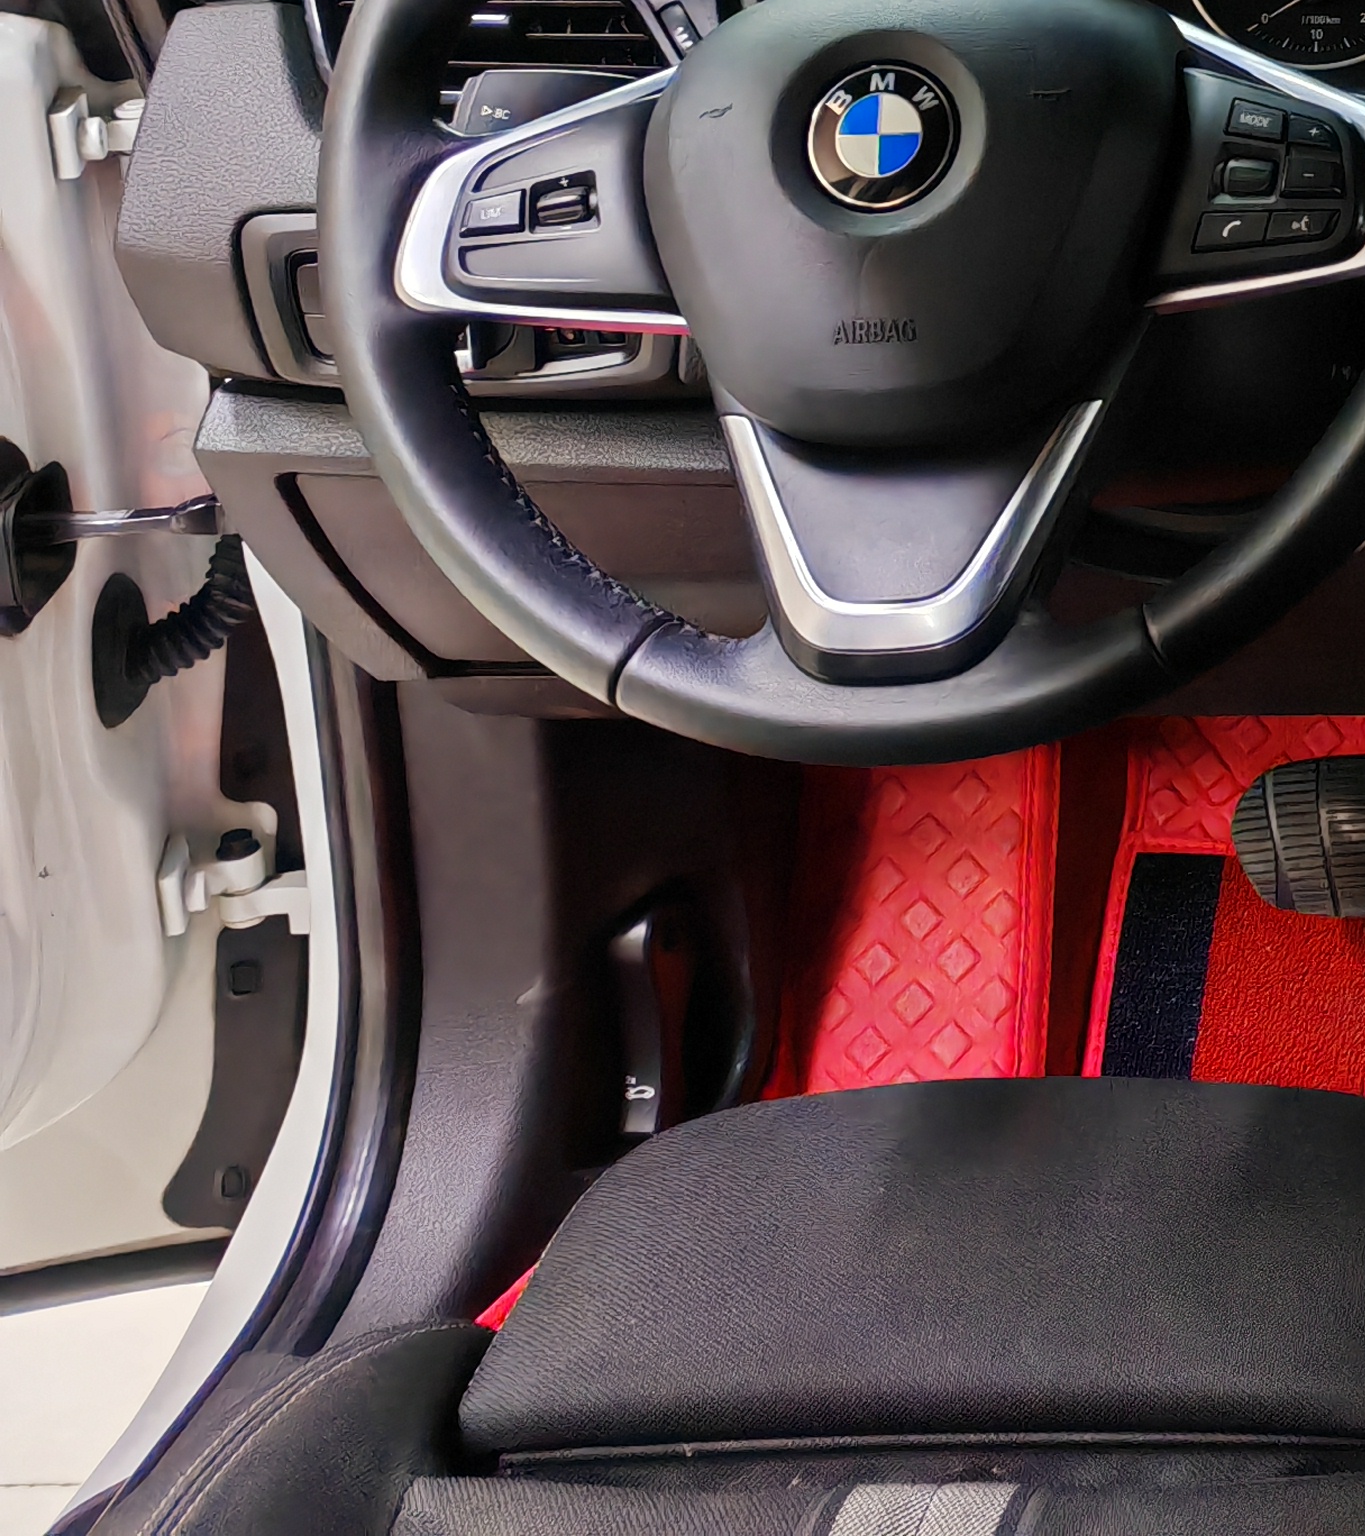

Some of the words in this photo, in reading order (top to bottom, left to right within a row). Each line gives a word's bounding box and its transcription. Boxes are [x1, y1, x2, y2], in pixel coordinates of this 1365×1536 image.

[1261, 14, 1269, 24] 0
[1310, 29, 1324, 40] 10
[825, 72, 940, 116] BMW
[833, 318, 918, 345] AIRBAG
